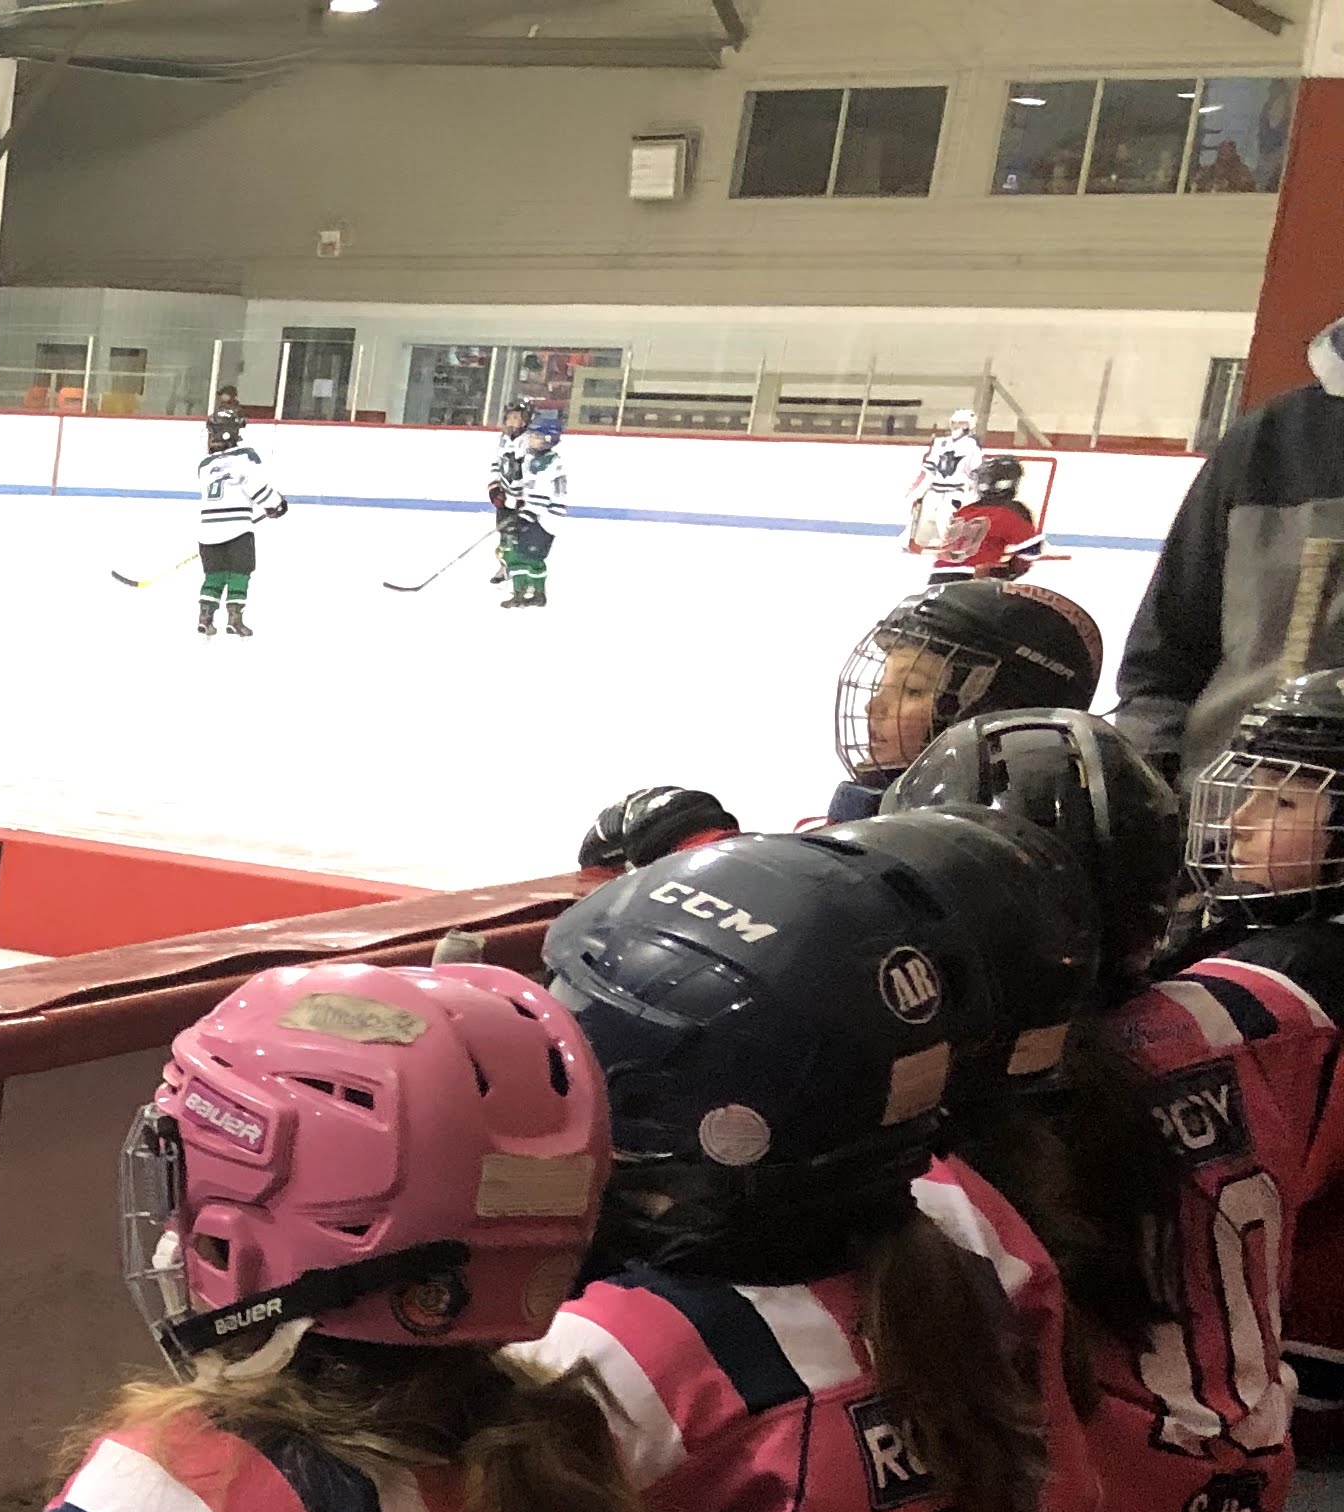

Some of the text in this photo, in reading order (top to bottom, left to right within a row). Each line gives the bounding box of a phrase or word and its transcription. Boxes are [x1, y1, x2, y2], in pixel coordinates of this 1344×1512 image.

[648, 880, 779, 944] CCM
[184, 1091, 265, 1145] BAUER
[214, 1296, 284, 1336] BAUER
